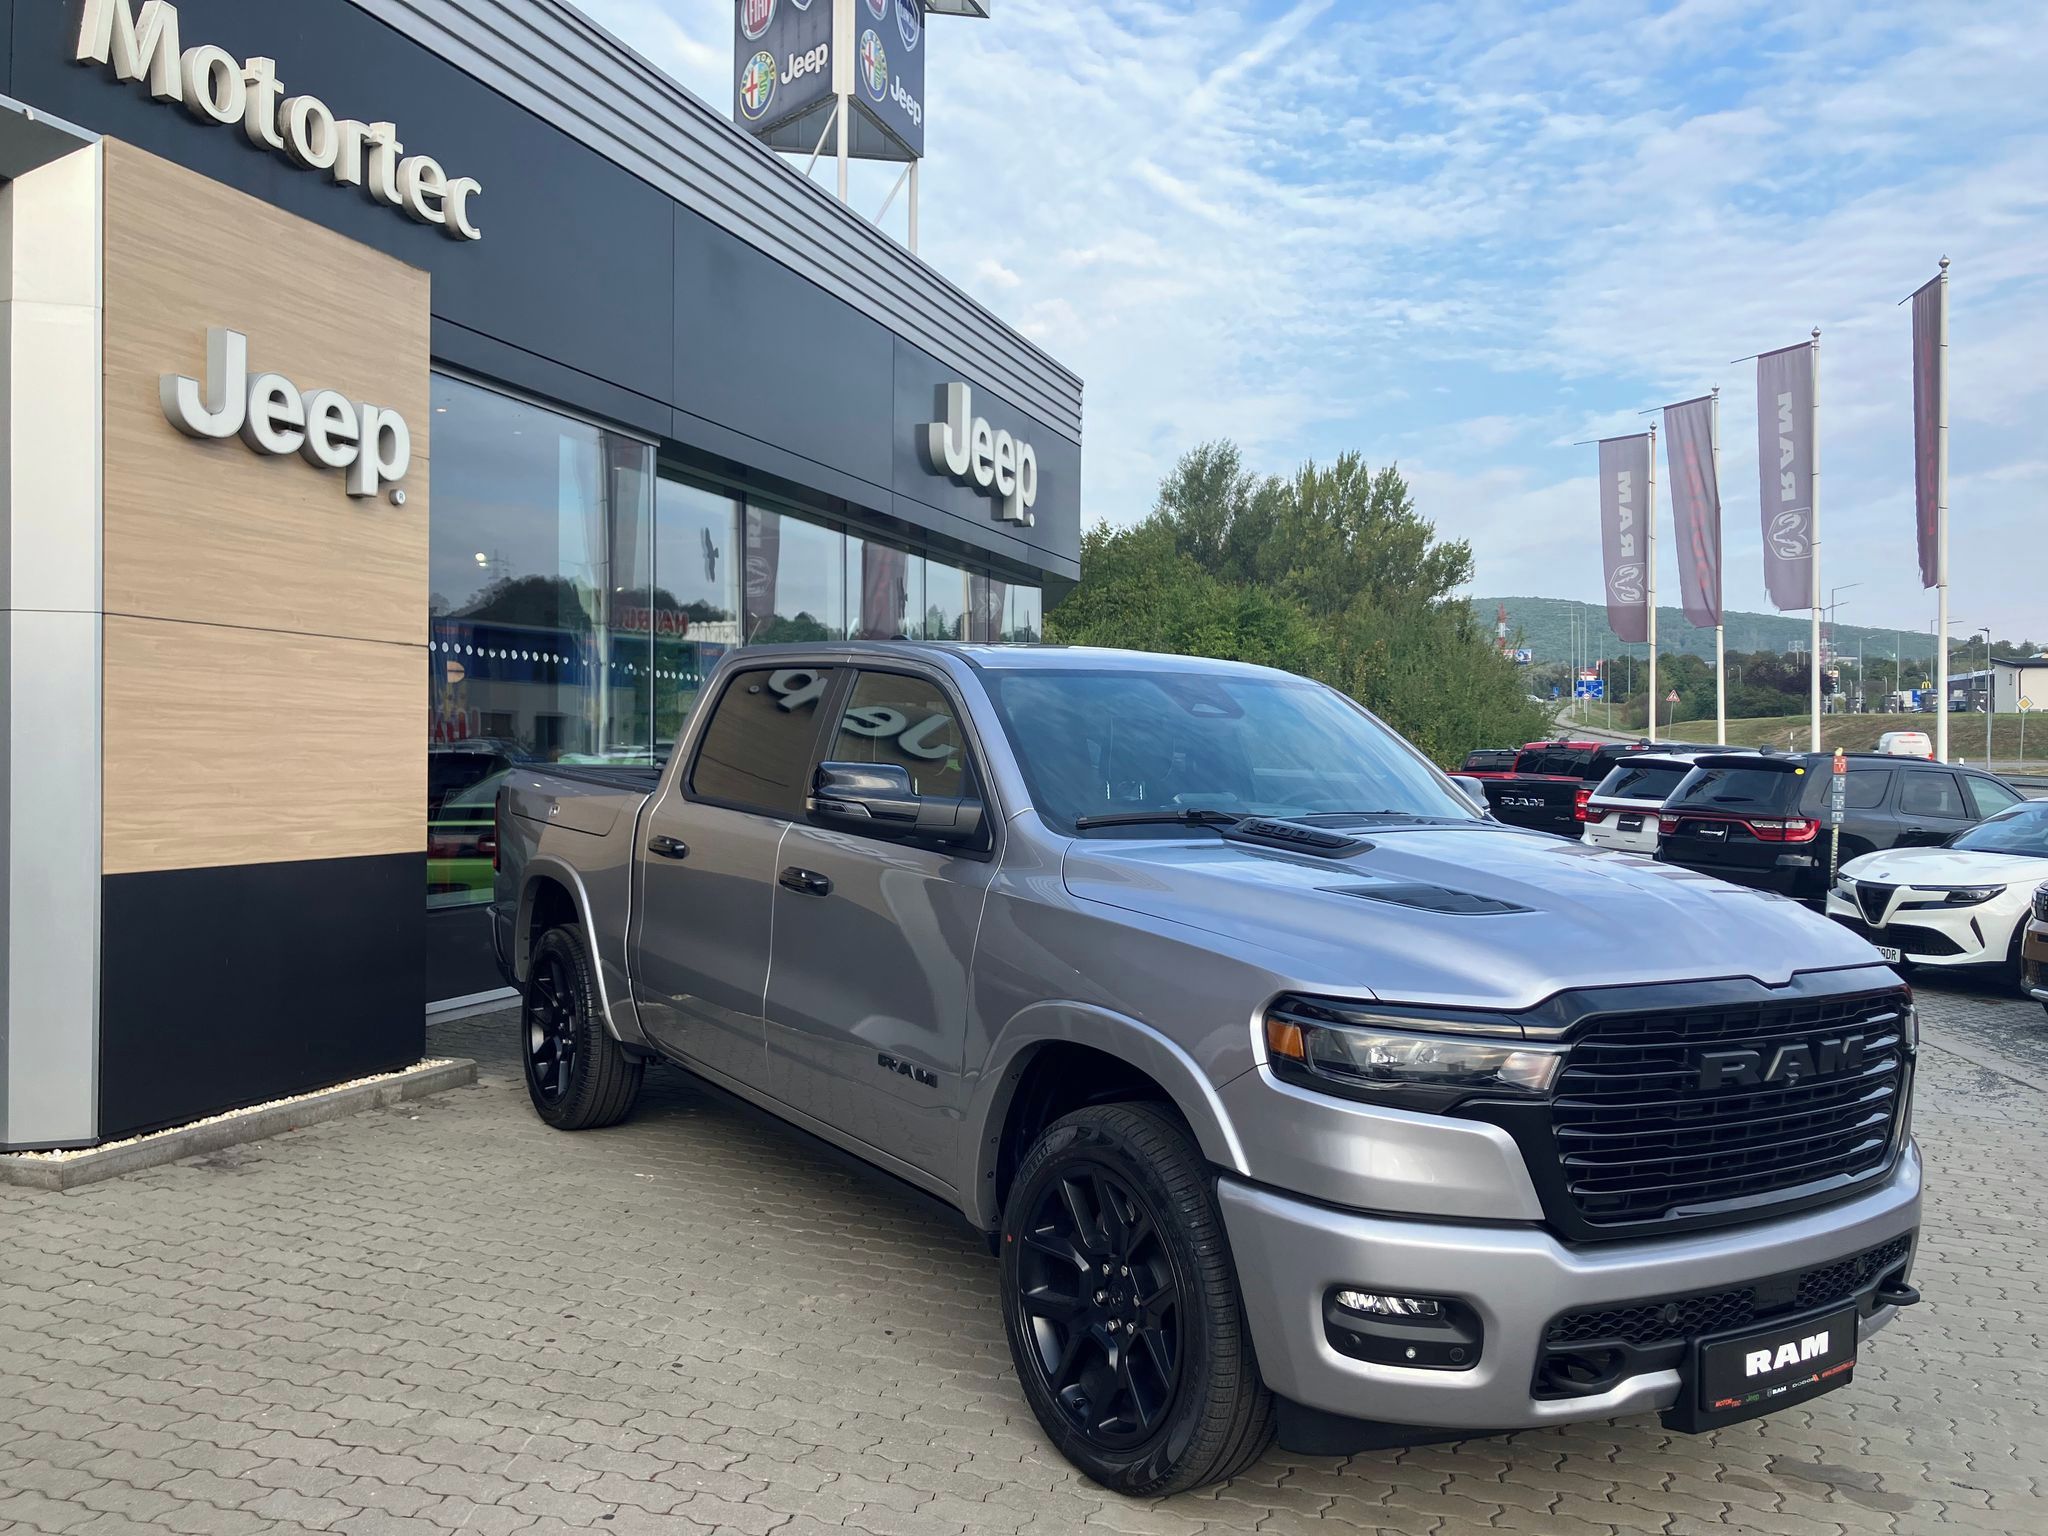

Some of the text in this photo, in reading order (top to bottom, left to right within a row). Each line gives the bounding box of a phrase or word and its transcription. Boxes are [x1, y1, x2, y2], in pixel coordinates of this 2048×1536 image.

[781, 43, 828, 84] Jeep
[76, 0, 482, 240] Motortec
[890, 75, 922, 126] Jeep
[159, 327, 411, 497] Jeep
[929, 382, 1037, 520] Jeep
[1500, 796, 1545, 807] RAM
[1876, 946, 1897, 961] 9DR
[877, 1053, 938, 1089] RAM
[1701, 1034, 1864, 1089] RAM
[1746, 1331, 1829, 1377] RAM
[1772, 1386, 1787, 1395] RAM
